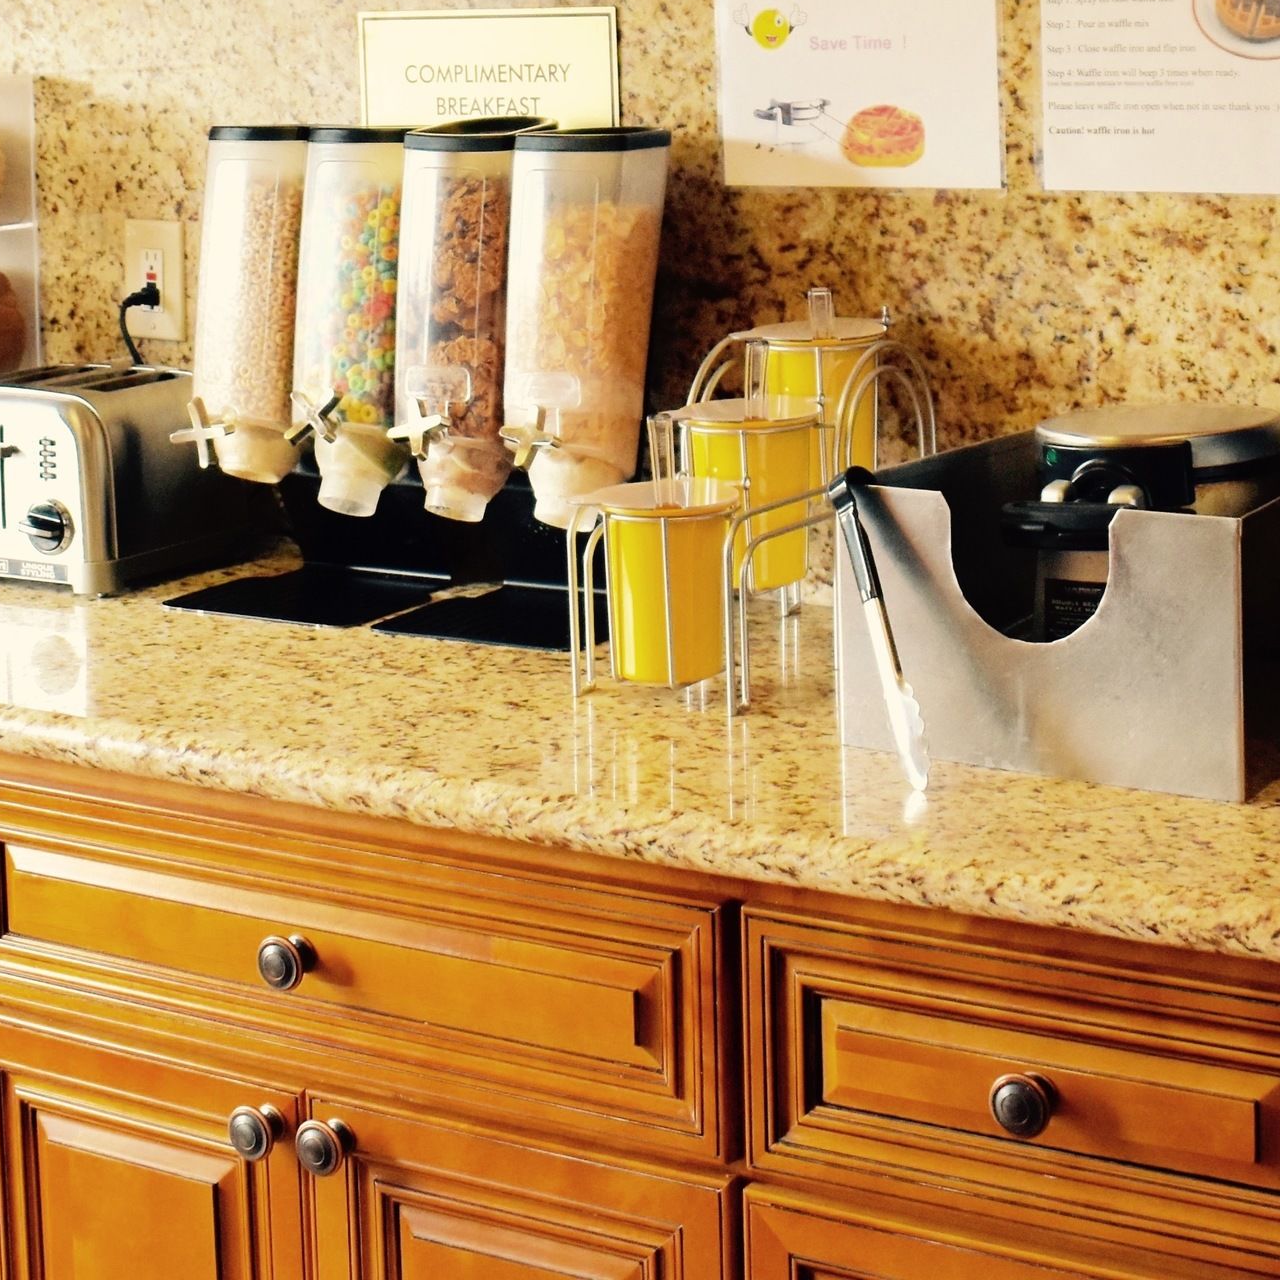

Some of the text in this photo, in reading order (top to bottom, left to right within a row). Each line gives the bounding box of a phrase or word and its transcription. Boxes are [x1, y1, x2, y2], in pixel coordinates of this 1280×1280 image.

[1046, 20, 1063, 29] Step
[1108, 18, 1132, 28] waffle
[809, 36, 847, 50] Save
[853, 36, 892, 50] Time
[1047, 44, 1064, 54] Step
[1078, 44, 1101, 53] Close
[1102, 43, 1127, 52] waffle
[1129, 44, 1145, 52] iron
[1146, 43, 1161, 52] and
[404, 64, 571, 83] COMPLIMENTARY
[1047, 69, 1065, 78] Step
[1076, 68, 1101, 77] Waffle
[1121, 67, 1136, 76] will
[1139, 67, 1158, 79] beep
[436, 97, 540, 116] BREAKFAST
[1048, 101, 1073, 110] Please
[1097, 101, 1121, 110] waffle
[1141, 103, 1160, 112] open
[1163, 102, 1184, 110] when
[1228, 101, 1251, 111] thank
[1049, 126, 1085, 135] Caution!
[1087, 126, 1111, 135] waffle
[1113, 126, 1130, 135] iron
[1141, 126, 1155, 135] hot
[22, 562, 54, 571] UNIQUE
[21, 568, 56, 579] STYLING
